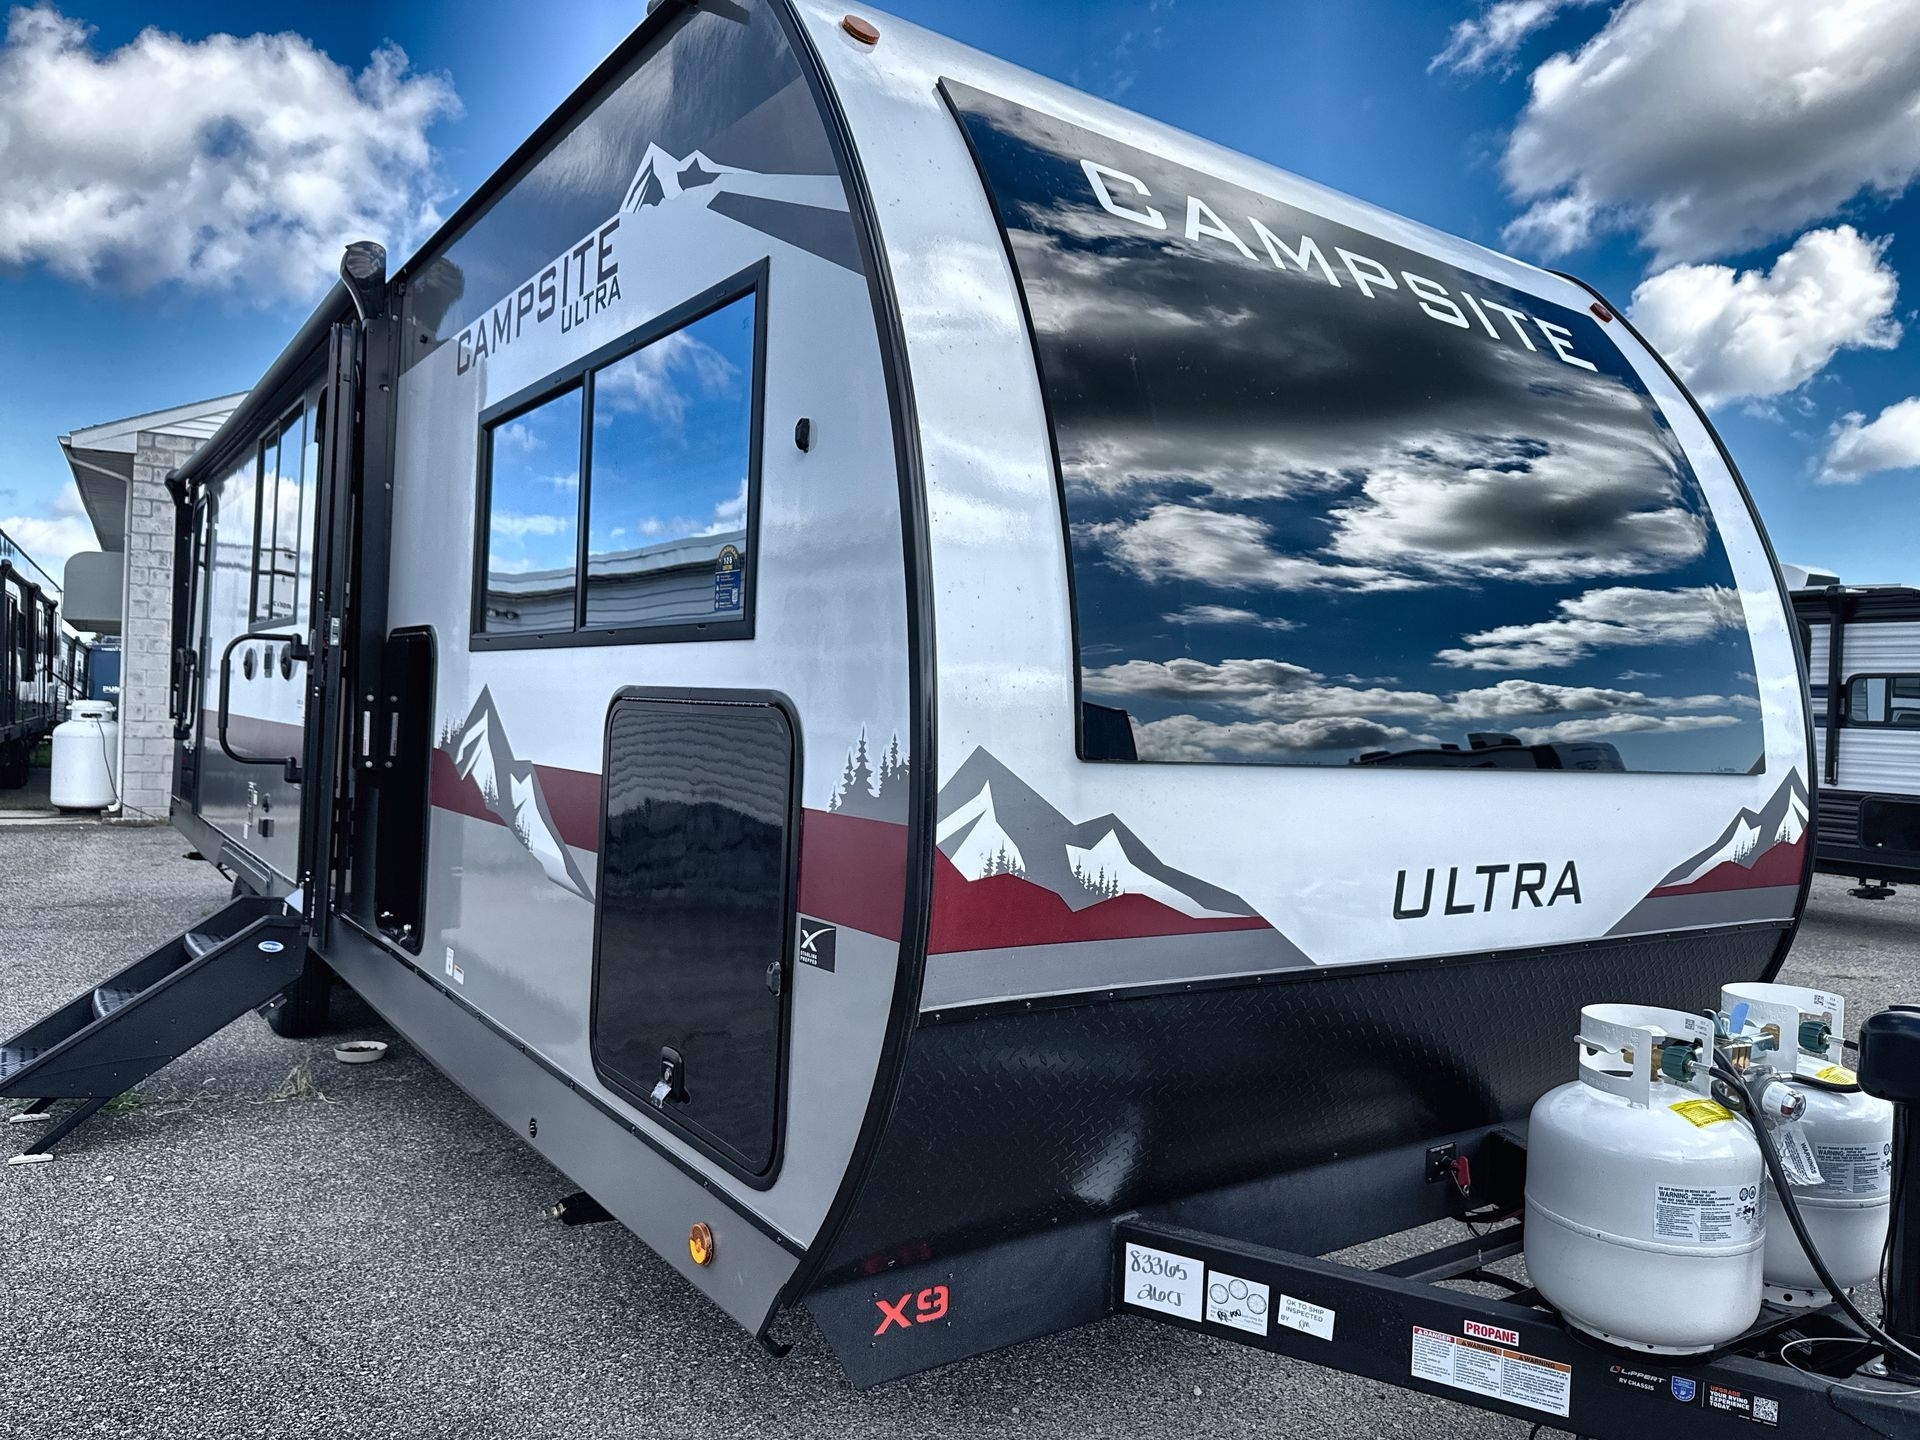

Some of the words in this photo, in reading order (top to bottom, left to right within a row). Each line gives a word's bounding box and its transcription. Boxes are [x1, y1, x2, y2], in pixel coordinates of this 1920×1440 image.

[1080, 159, 1598, 372] CAMPSITE
[457, 218, 620, 376] CAMPSITE
[561, 275, 621, 334] ULTRA
[1393, 860, 1582, 920] ULTRA
[1801, 1142, 1817, 1174] WARNINGS
[874, 1285, 950, 1337] X9
[1285, 1305, 1323, 1322] INSPECTED
[1286, 1299, 1297, 1307] OK
[1298, 1302, 1307, 1310] TO
[1308, 1306, 1325, 1316] SHIP
[1280, 1314, 1290, 1322] BY
[1423, 1330, 1452, 1342] DANGER
[1466, 1322, 1517, 1344] PROPANE
[1466, 1341, 1498, 1354] WARNING
[1522, 1355, 1556, 1370] WARNING
[1628, 1379, 1654, 1391] CHASSIS
[1710, 1384, 1741, 1397] UPGRADE
[1709, 1390, 1728, 1399] YOUR
[1709, 1395, 1750, 1411] EXPERIENCE
